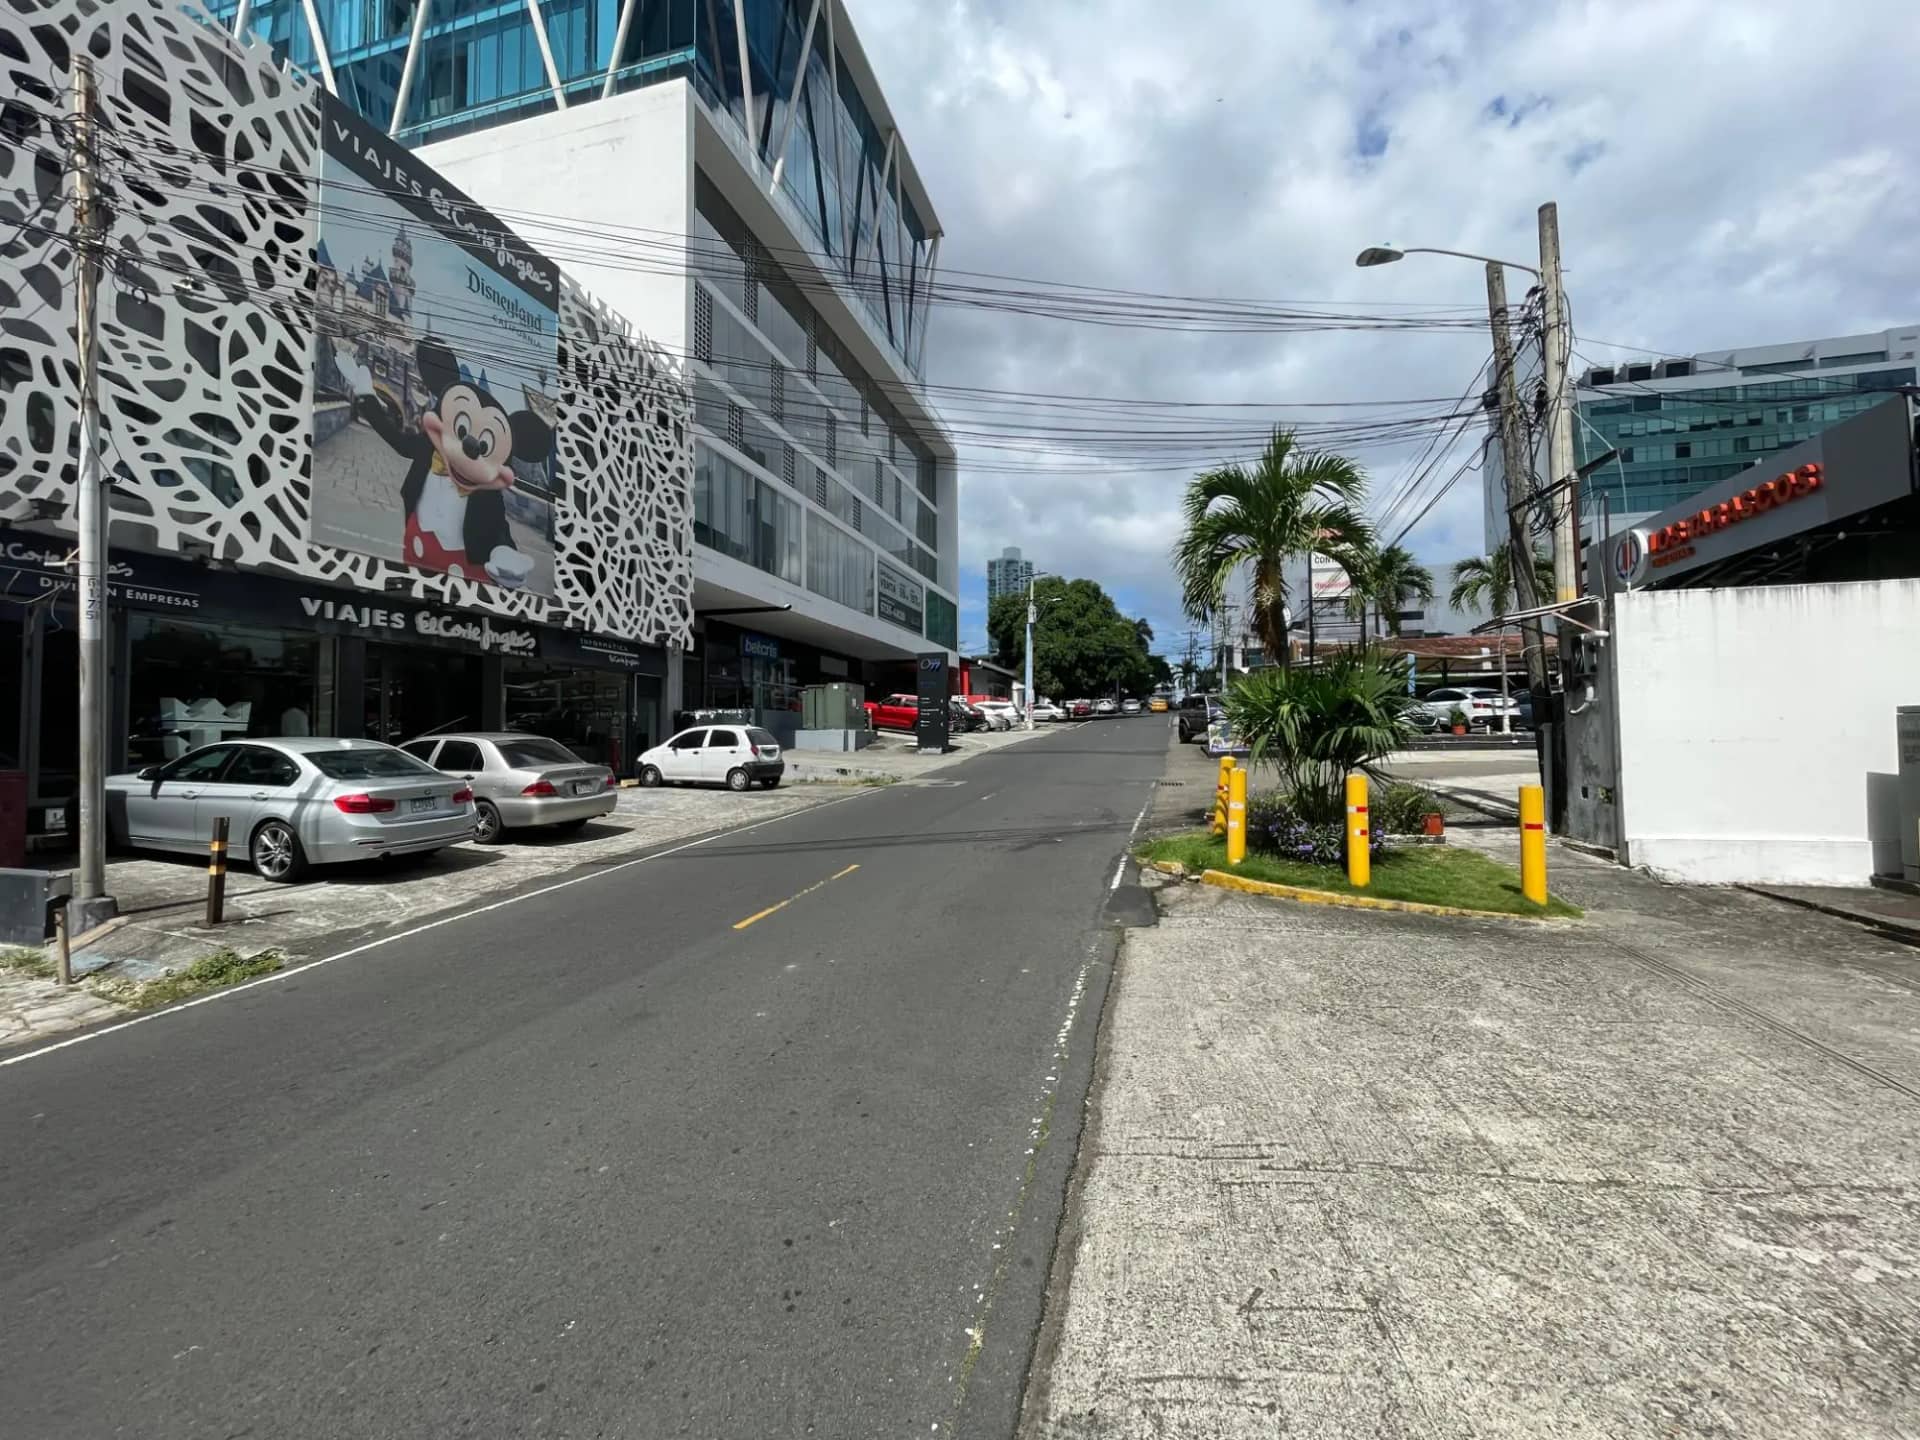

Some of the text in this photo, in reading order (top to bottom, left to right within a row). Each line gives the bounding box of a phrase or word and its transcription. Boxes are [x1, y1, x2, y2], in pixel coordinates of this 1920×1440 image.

[332, 119, 423, 198] VIAJES
[464, 264, 543, 333] Disneyland
[126, 588, 200, 609] EMPRESAS
[301, 597, 406, 629] VIAJES
[480, 616, 536, 653] Inglés
